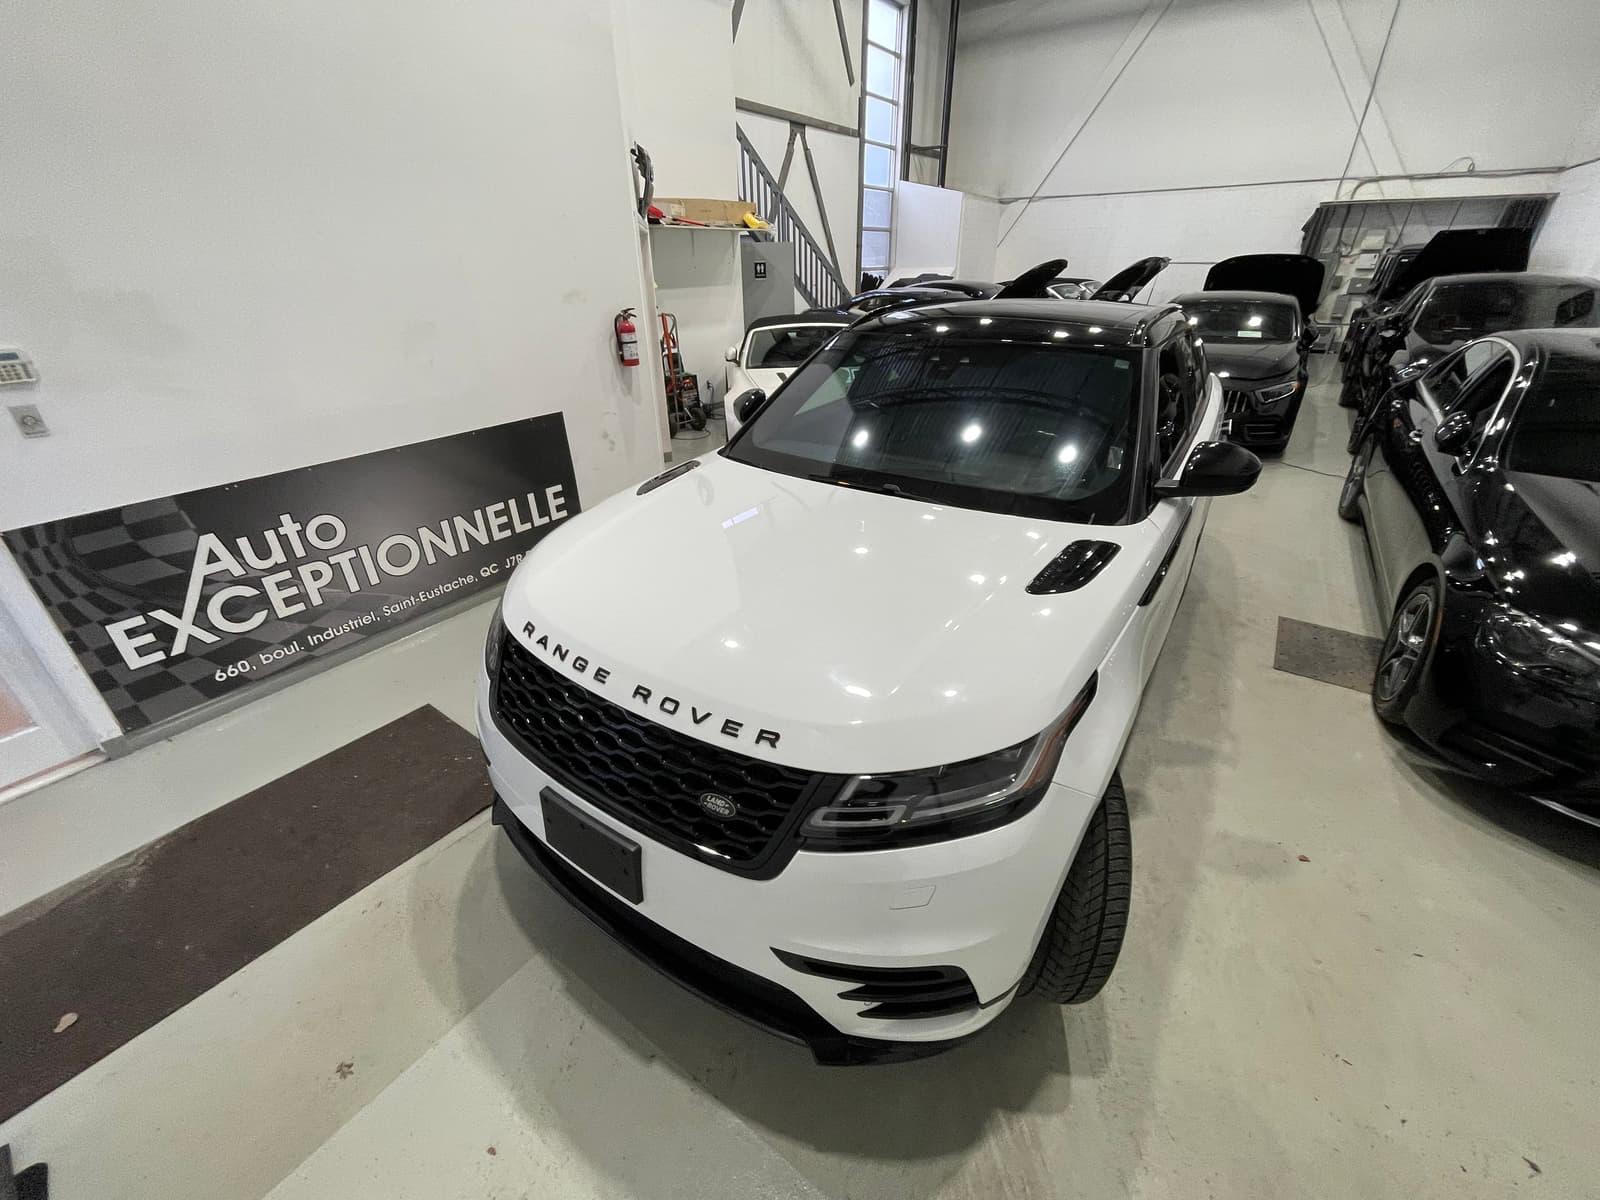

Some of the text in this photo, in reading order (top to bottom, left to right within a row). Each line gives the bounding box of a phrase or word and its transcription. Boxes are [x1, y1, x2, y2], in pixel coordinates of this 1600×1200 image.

[104, 484, 568, 670] EXCEPTIONNELLE
[196, 512, 347, 578] Auto
[214, 660, 257, 682] 660,
[259, 640, 305, 665] boul.
[307, 611, 381, 646] Industriel,
[382, 573, 479, 617] Saint-Eustache,
[479, 563, 499, 577] QC
[522, 621, 781, 749] RANGE ROVER
